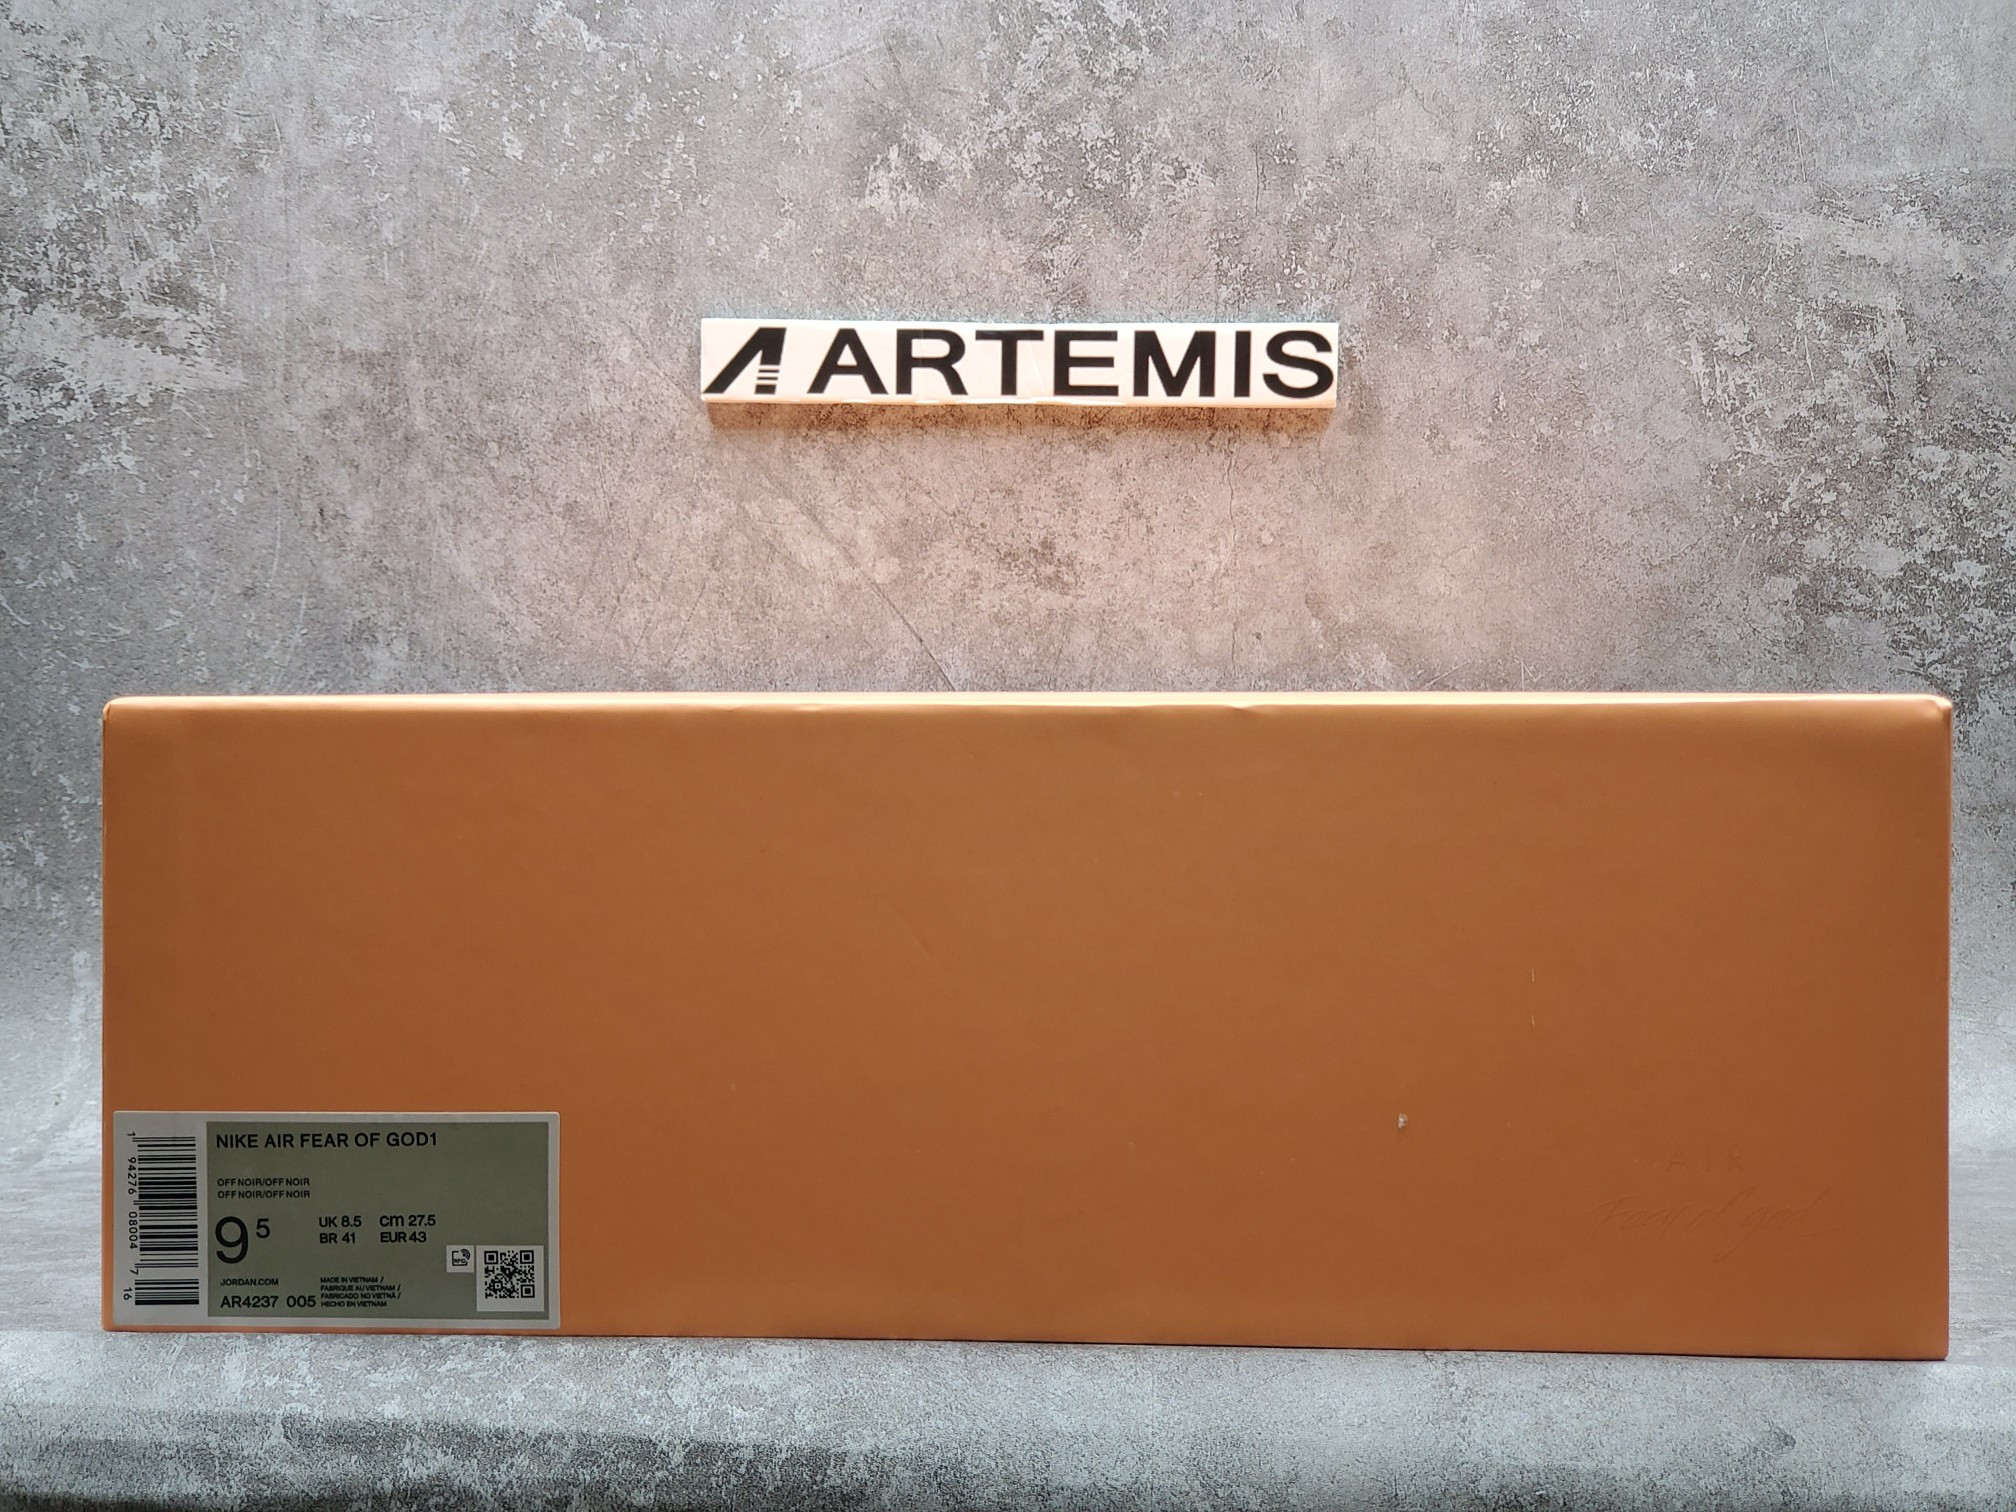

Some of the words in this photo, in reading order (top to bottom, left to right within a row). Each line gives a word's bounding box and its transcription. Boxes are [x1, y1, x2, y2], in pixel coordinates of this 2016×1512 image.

[807, 327, 1335, 399] ARTEMIS
[216, 1134, 258, 1148] NIKE
[264, 1133, 294, 1148] AIR
[300, 1133, 349, 1148] FEAR
[354, 1132, 381, 1147] OF
[386, 1131, 437, 1147] GOD1
[1663, 1143, 1746, 1173] AIR
[127, 1156, 137, 1195] 94276
[217, 1178, 236, 1187] OFF
[237, 1177, 285, 1187] NOIR/OFF
[285, 1177, 310, 1186] NOIR
[217, 1190, 236, 1199] OFF
[238, 1190, 285, 1199] NOIR/OFF
[286, 1190, 311, 1199] NOIR
[319, 1216, 338, 1228] UK
[341, 1216, 362, 1227] 8.5
[408, 1214, 436, 1226] 27.5
[128, 1211, 138, 1250] 08004
[319, 1232, 338, 1244] BR
[341, 1232, 356, 1244] 41
[380, 1231, 407, 1243] EUR
[408, 1231, 427, 1243] 43
[215, 1216, 249, 1264] 9
[256, 1218, 271, 1239] 5
[220, 1278, 279, 1287] JORDAN.COM
[123, 1287, 133, 1301] 16
[220, 1296, 278, 1308] AR4237
[286, 1295, 317, 1308] 005
